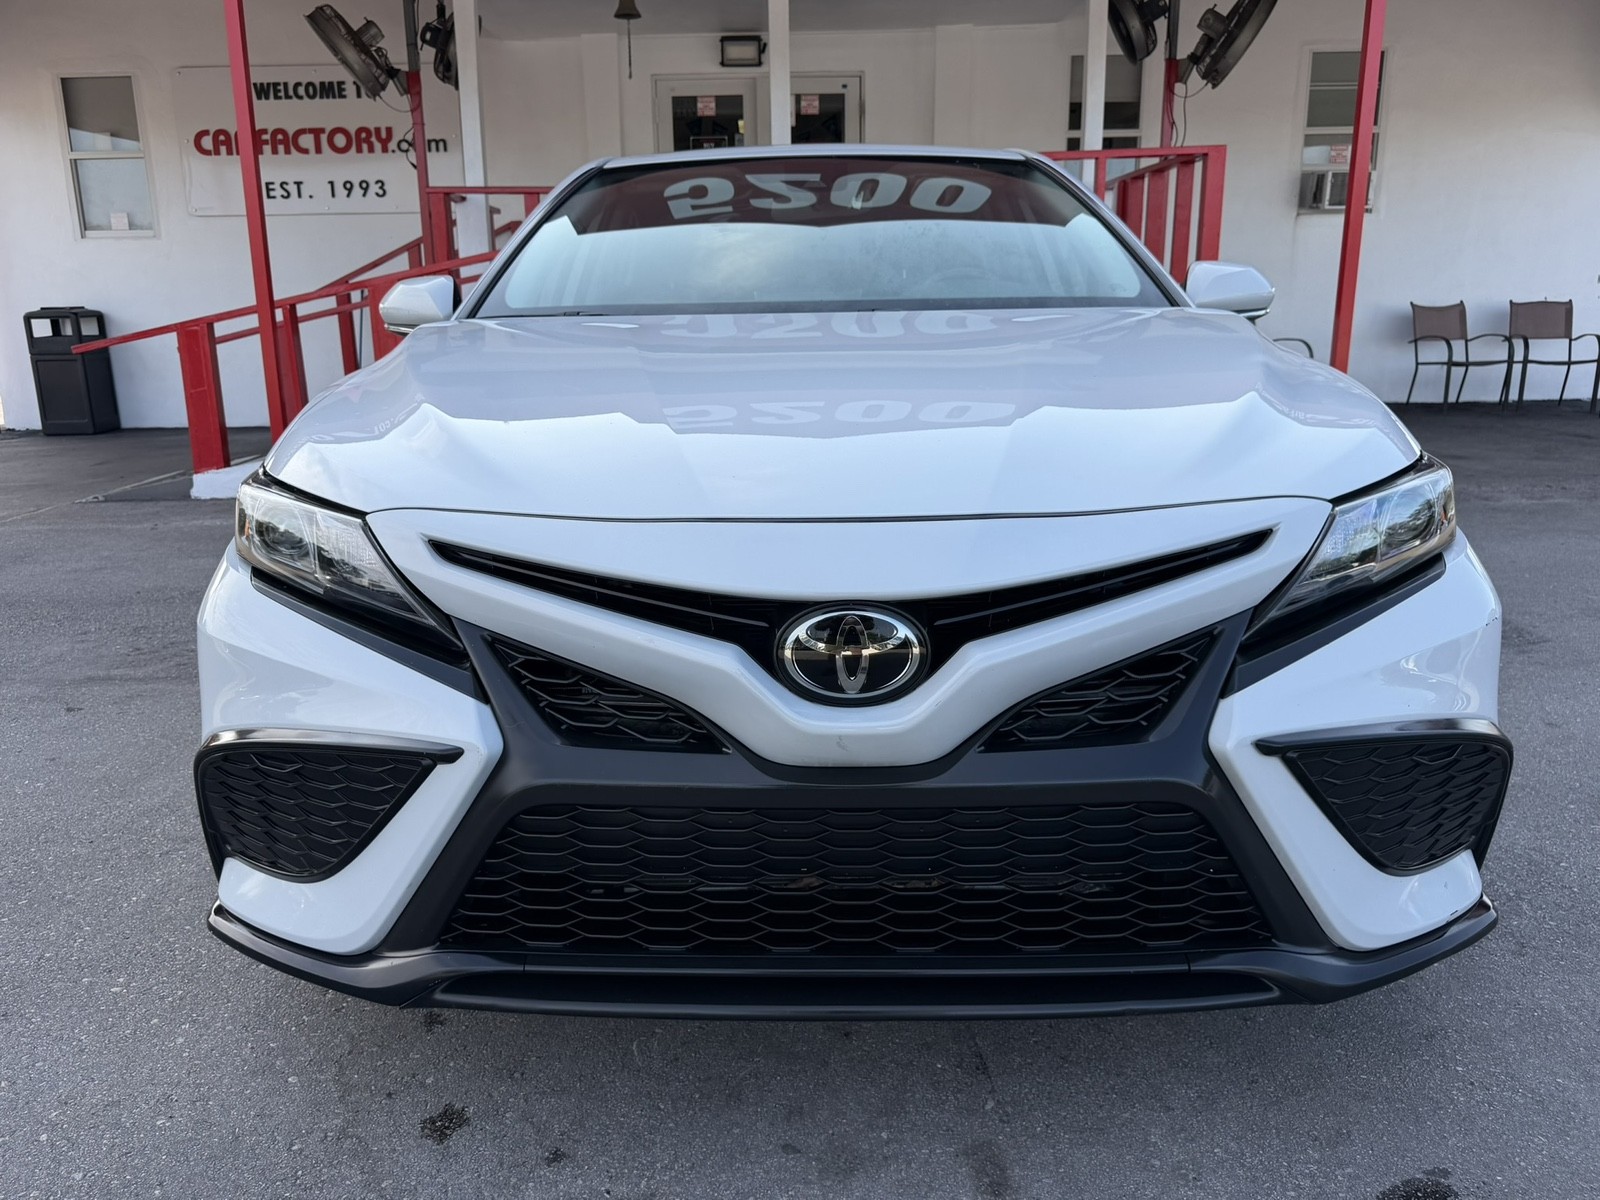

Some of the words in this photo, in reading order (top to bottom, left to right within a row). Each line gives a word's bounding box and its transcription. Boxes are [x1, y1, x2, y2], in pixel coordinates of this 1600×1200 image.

[253, 81, 347, 100] WELCOME
[264, 181, 314, 199] EST.
[327, 179, 387, 199] 1993
